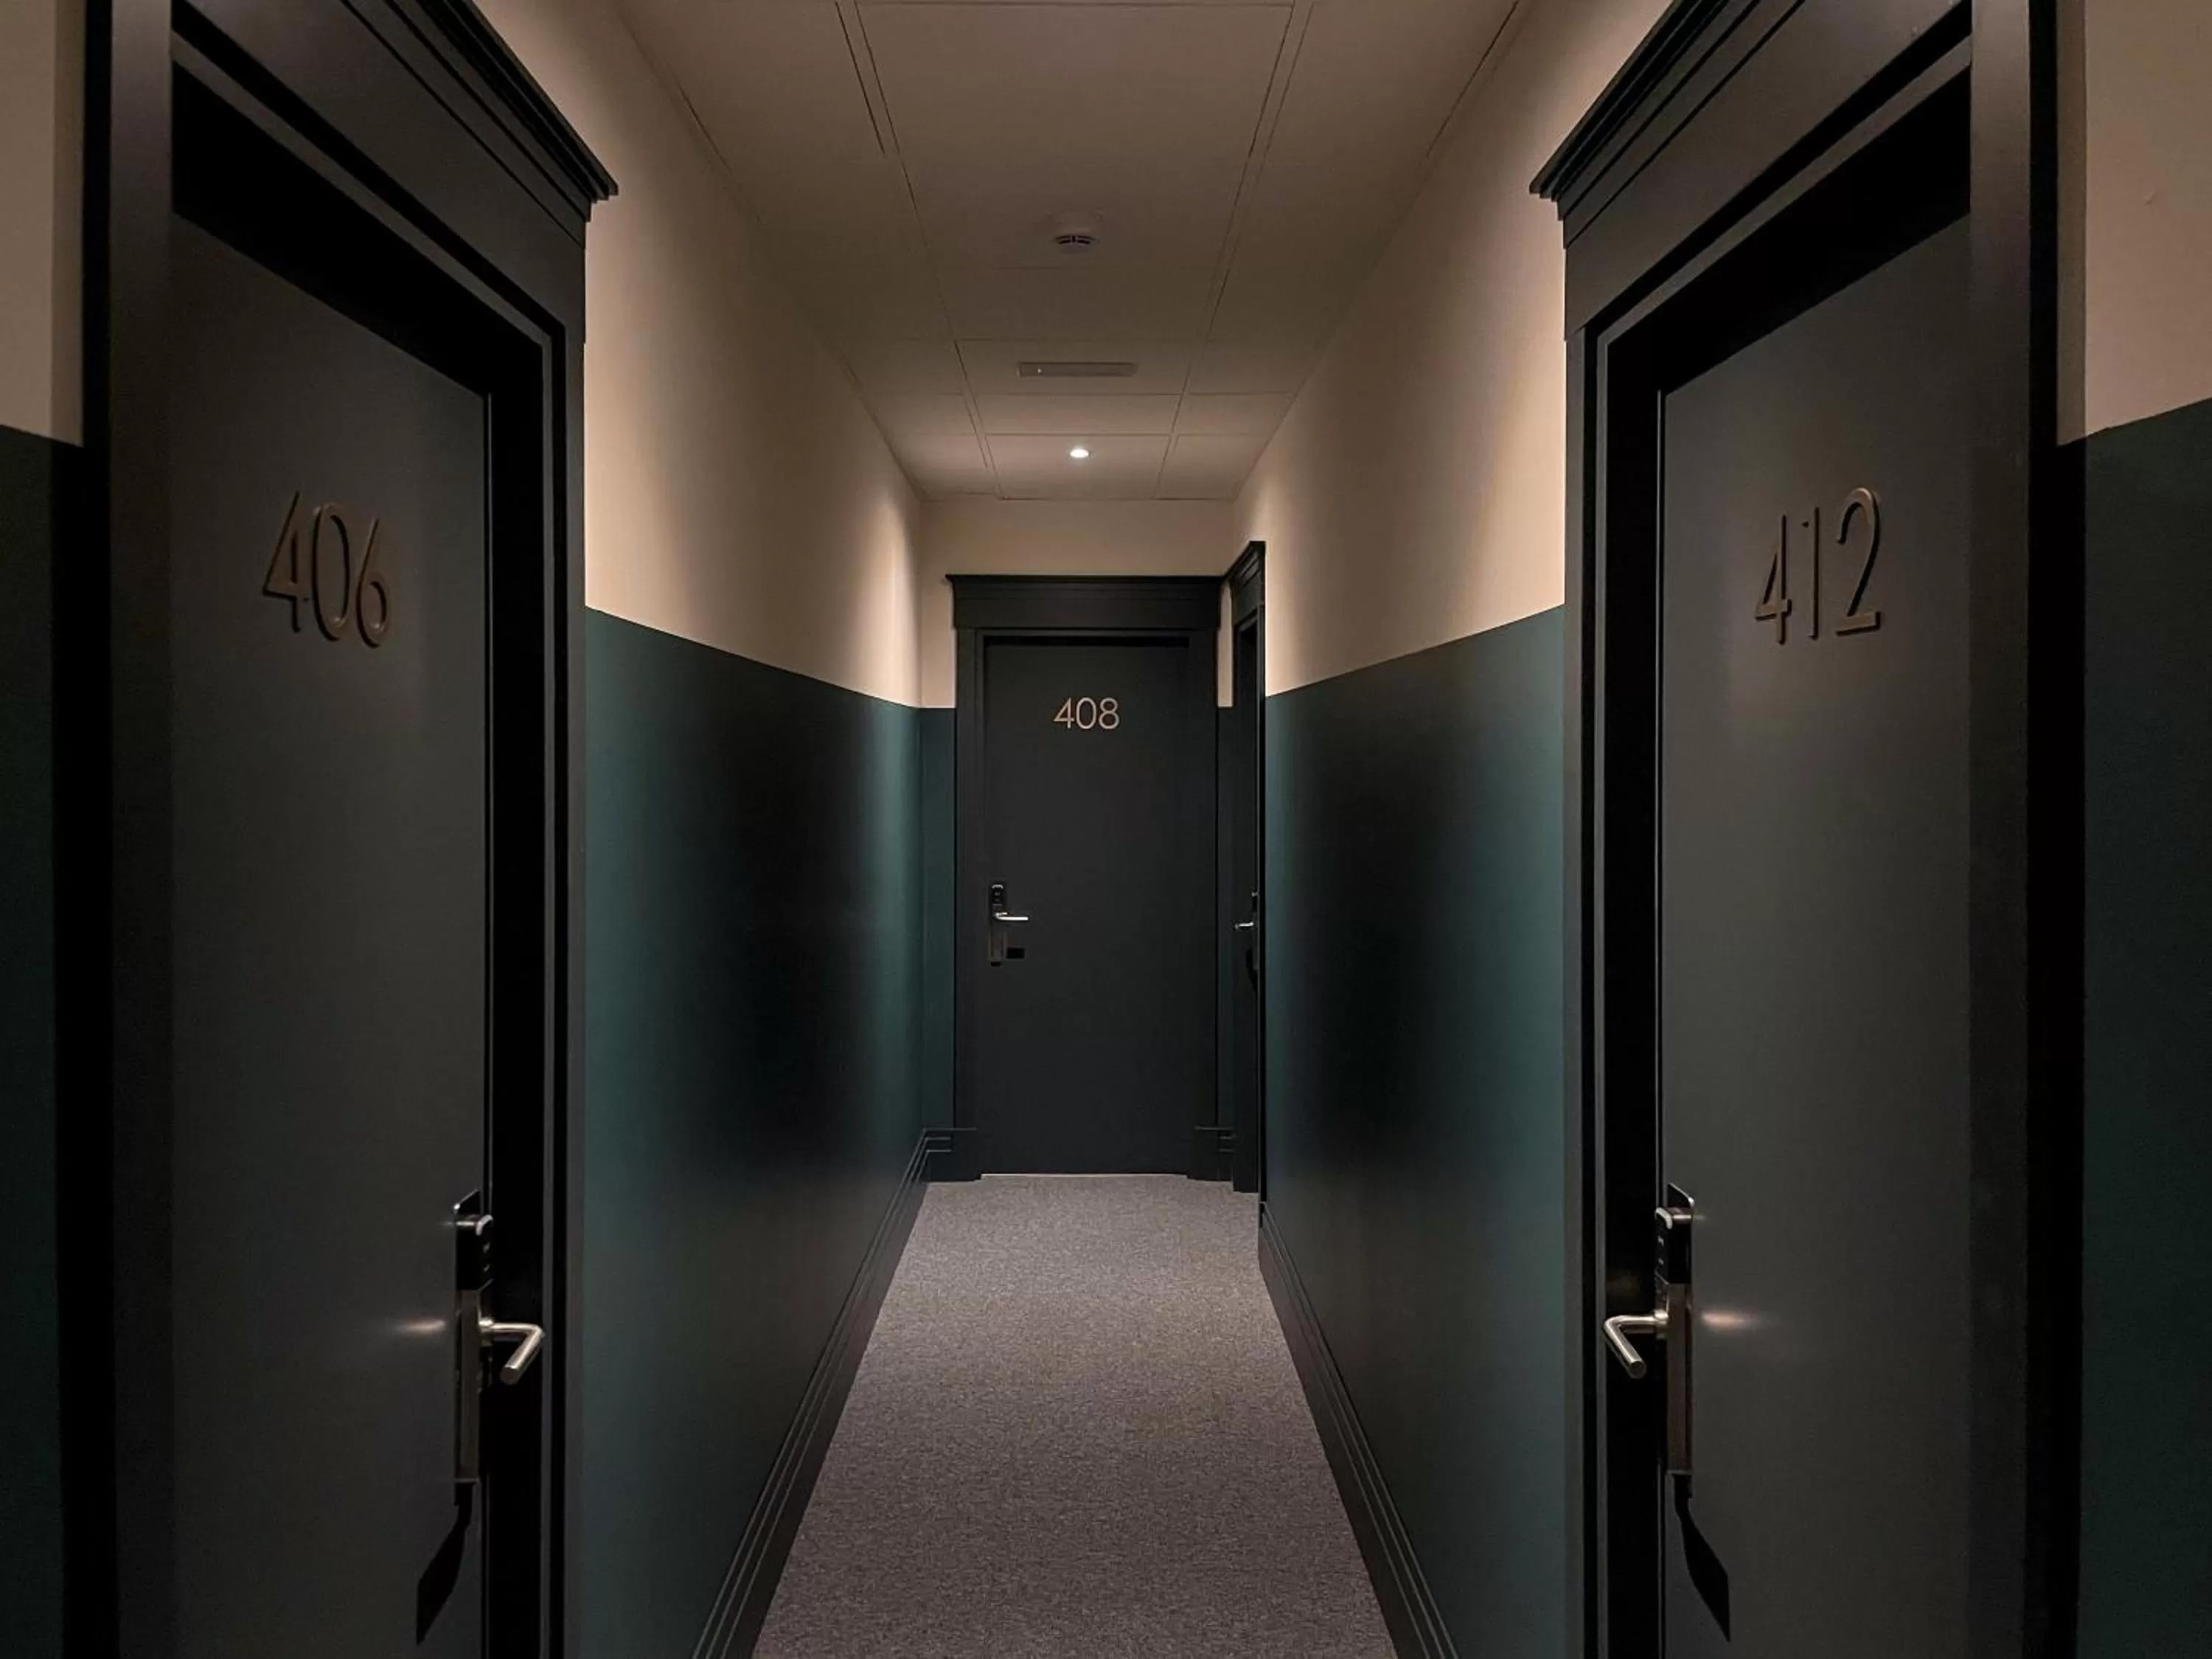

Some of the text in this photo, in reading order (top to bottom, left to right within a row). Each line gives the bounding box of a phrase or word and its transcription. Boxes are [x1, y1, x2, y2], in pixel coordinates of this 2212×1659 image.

[262, 490, 388, 648] 406
[1755, 487, 1881, 644] 412
[1053, 697, 1119, 729] 408
